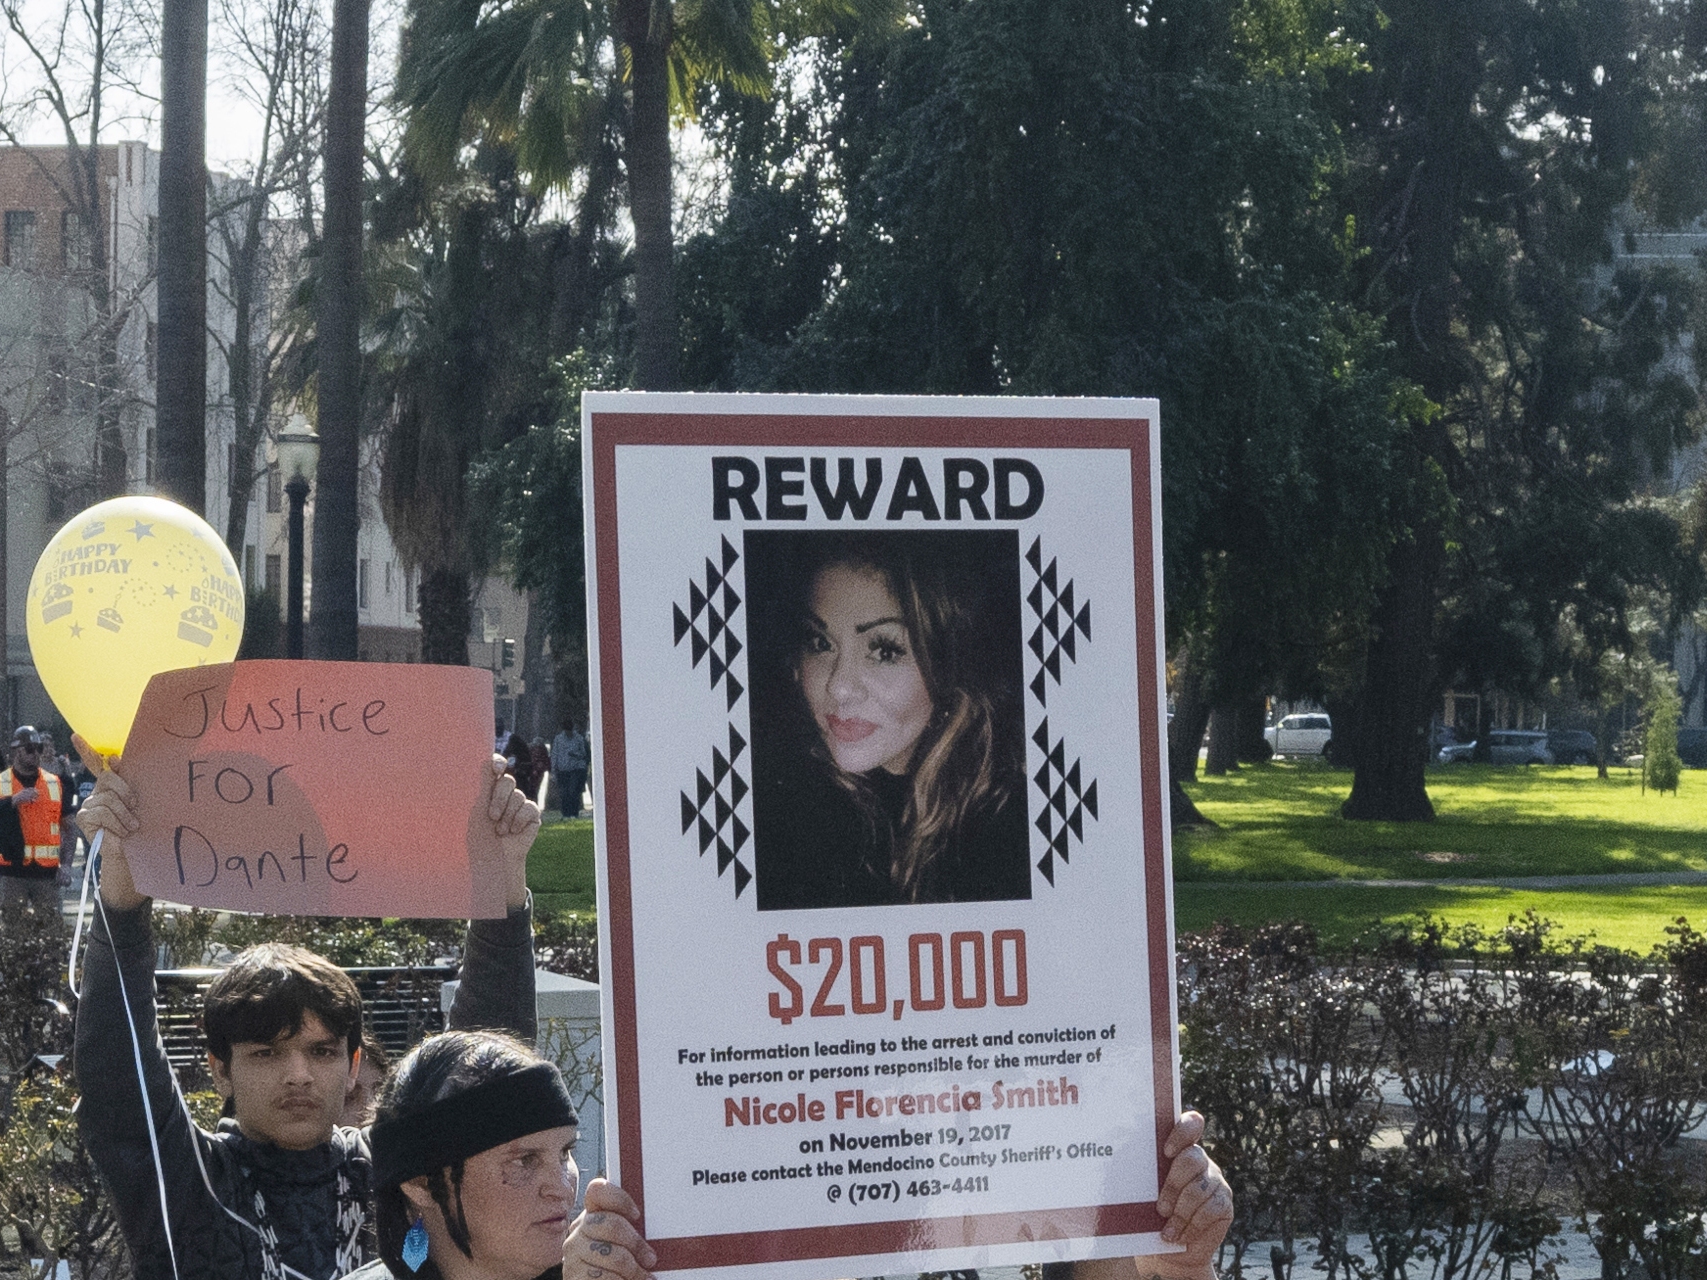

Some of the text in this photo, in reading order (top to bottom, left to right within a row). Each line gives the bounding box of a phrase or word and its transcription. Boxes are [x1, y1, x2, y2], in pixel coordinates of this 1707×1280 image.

[712, 457, 1044, 521] REWARD
[45, 559, 133, 584] BIRTHDAY
[60, 542, 122, 563] HAPPY
[190, 582, 244, 624] BIRTHD
[164, 685, 389, 739] Justice
[188, 760, 294, 805] For
[174, 825, 358, 889] Dante
[766, 929, 1028, 1025] $20,000
[678, 1025, 1115, 1064] For information leading to the arrest and conviction of
[696, 1048, 1101, 1087] the person or persons responsible for the murder of
[724, 1076, 1079, 1127] Nicole Florencia Smith
[799, 1124, 1011, 1154] on November 19, 2017
[692, 1142, 1113, 1185] Please contact the Mendocino County Sheriff's Office
[827, 1176, 989, 1206] @ (707) 463-4411
